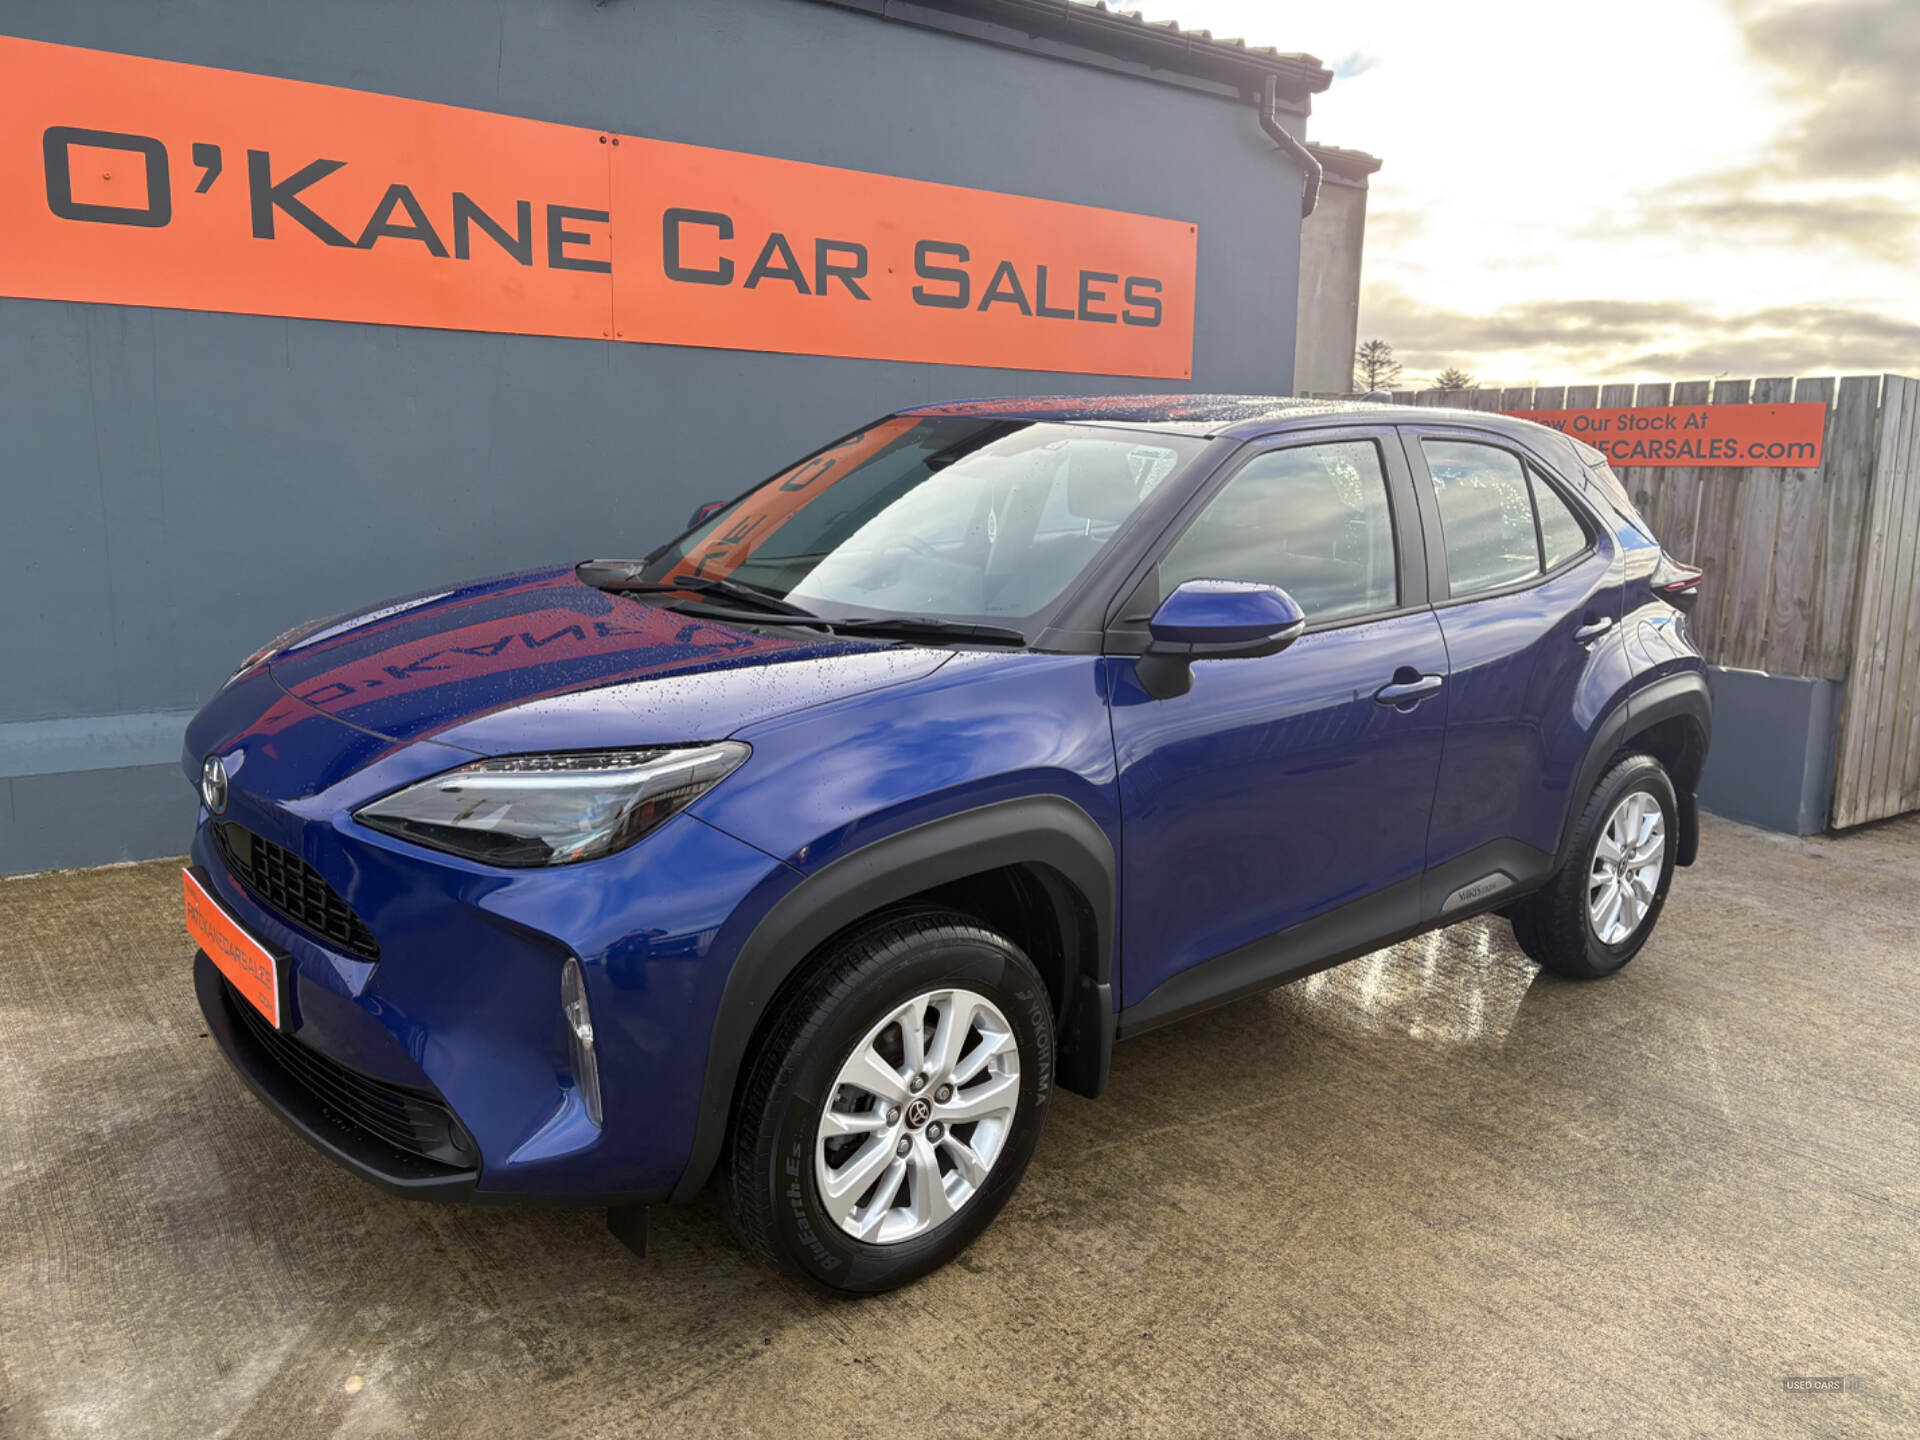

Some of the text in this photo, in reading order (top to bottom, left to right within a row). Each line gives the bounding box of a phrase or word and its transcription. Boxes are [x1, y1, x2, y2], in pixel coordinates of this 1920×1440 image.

[42, 125, 1163, 328] O'KANE CAR SALES
[1532, 411, 1708, 432] ew Our Stock At
[1025, 999, 1051, 1107] YOKOHAMA
